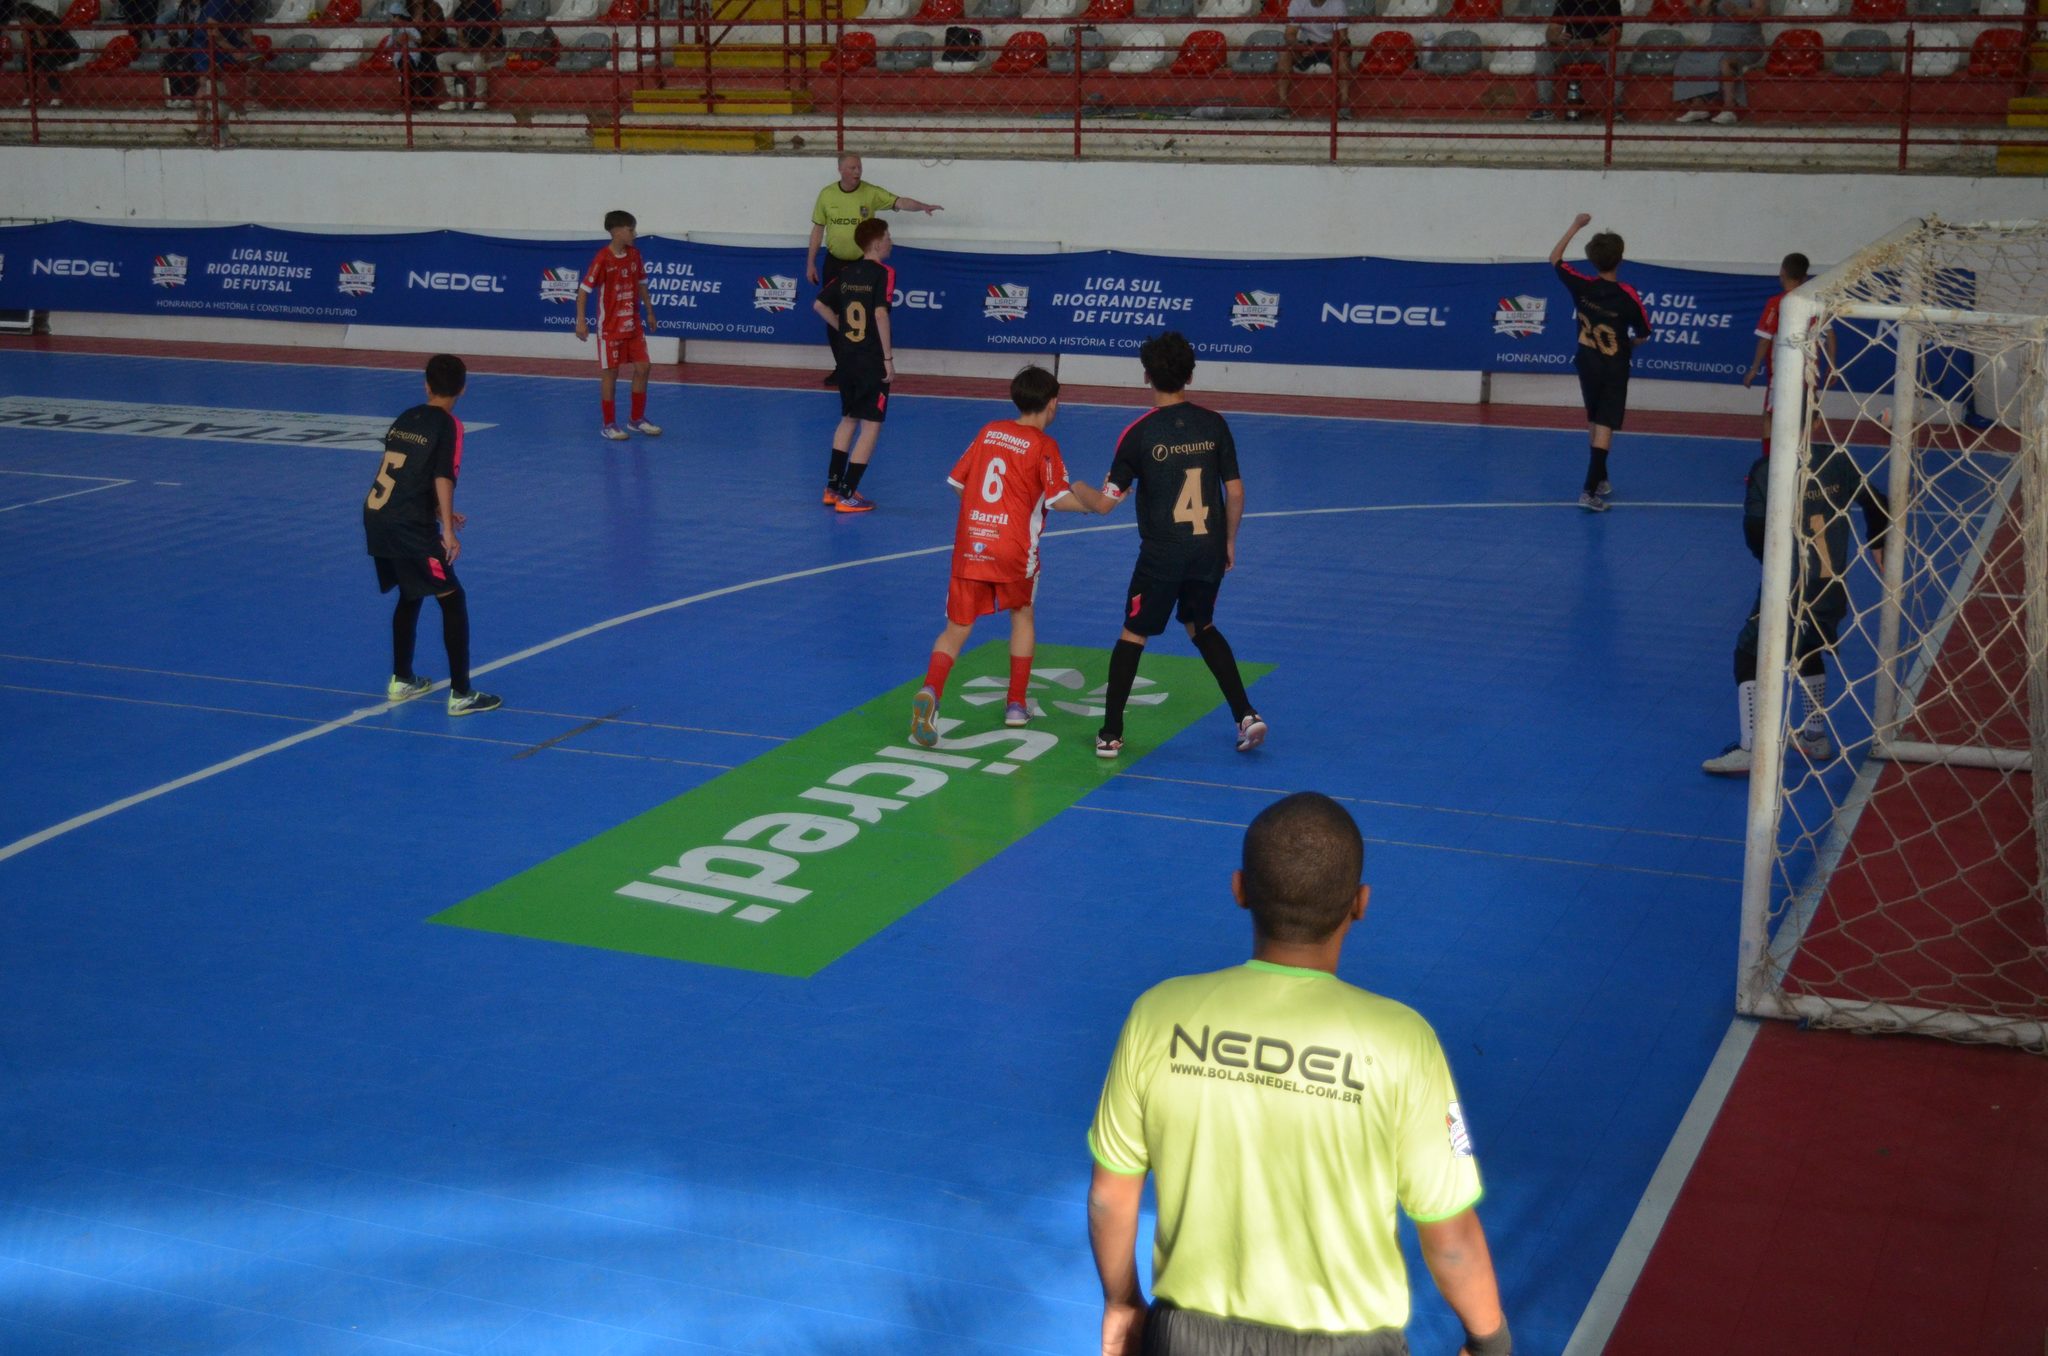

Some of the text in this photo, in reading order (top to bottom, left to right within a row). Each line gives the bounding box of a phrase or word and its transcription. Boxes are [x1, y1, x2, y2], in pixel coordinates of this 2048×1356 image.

[231, 249, 289, 263] LIGA SUL
[33, 258, 120, 277] NEDEL
[207, 263, 312, 279] RIOGRANDENSE
[644, 261, 694, 276] GA SUL
[223, 278, 293, 292] DE FUTSAL
[408, 271, 504, 293] NEDEL
[648, 278, 722, 293] ANDENSE
[1085, 277, 1163, 294] LIGA SUL
[157, 300, 203, 309] HONRANDO
[213, 302, 248, 310] HISTÓRIA
[257, 304, 315, 314] CONSTRUINDO
[325, 308, 358, 317] FUTURO
[641, 293, 697, 307] UTSAL
[1052, 293, 1193, 311] RIOGRANDENSE
[1660, 294, 1697, 309] SUL
[845, 301, 866, 342] 9
[1073, 310, 1166, 326] DE FUTSAL
[1321, 302, 1446, 327] NEDEL
[544, 316, 597, 326] HONRADO
[656, 321, 724, 332] CONSTRUINDO
[726, 324, 734, 332] O
[736, 325, 775, 334] FUTURO
[1578, 312, 1618, 356] 20
[987, 335, 1047, 346] HONRANDO
[1049, 337, 1057, 346] A
[1059, 336, 1106, 347] HISTÓRIA
[1110, 339, 1115, 347] E
[1198, 343, 1207, 352] O
[1209, 343, 1253, 354] FUTURO
[1497, 353, 1567, 364] HONRANDO
[1637, 359, 1643, 368] E
[1647, 359, 1734, 374] CONSTRUINDO
[1736, 364, 1746, 374] O
[986, 431, 1030, 449] PEDRINHO
[1170, 440, 1215, 456] requinte
[367, 451, 407, 511] 5
[981, 457, 1007, 503] 6
[1173, 467, 1209, 536] 4
[970, 509, 1008, 525] Barril
[1810, 514, 1832, 578] 1
[614, 718, 1060, 923] sicredi
[1169, 1022, 1365, 1092] NEDEL
[1170, 1063, 1362, 1105] WWW.BOLASNEDEL.COM.BR
